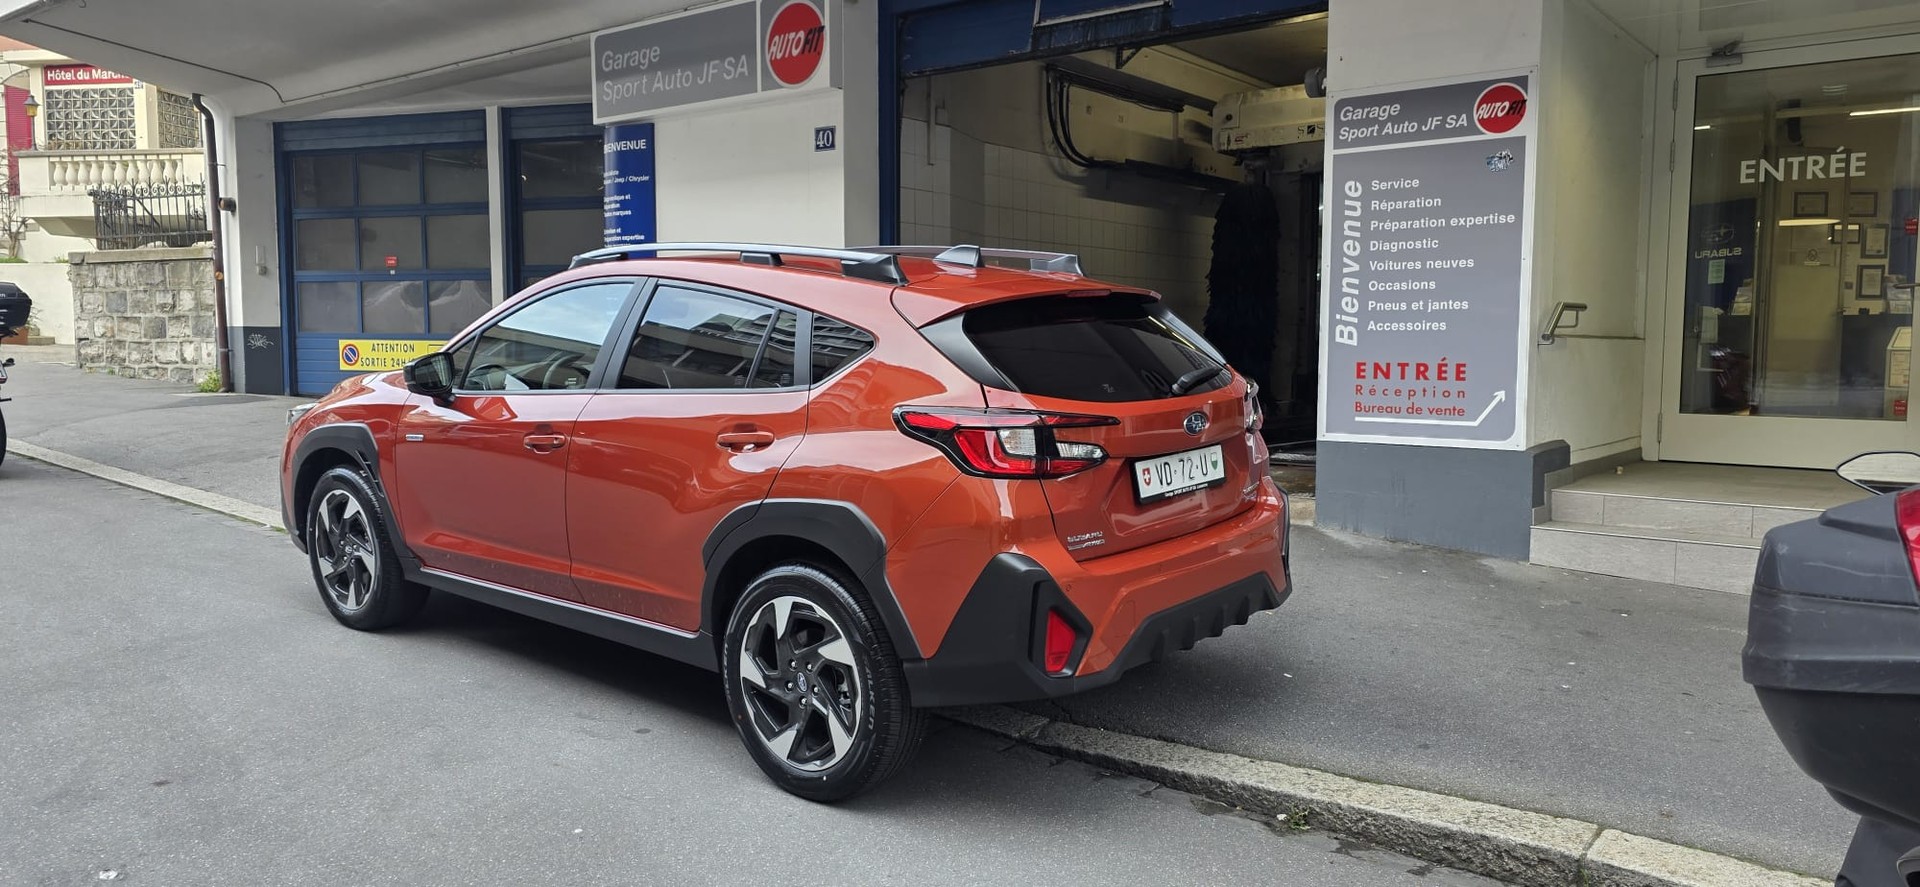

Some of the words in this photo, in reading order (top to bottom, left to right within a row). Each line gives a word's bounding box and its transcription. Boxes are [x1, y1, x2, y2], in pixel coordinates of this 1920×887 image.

[768, 25, 825, 61] AUTOFIT
[602, 46, 661, 72] Garage
[47, 69, 75, 81] Hôtel
[76, 69, 90, 80] du
[91, 68, 130, 79] Marc
[602, 75, 648, 104] Sport
[652, 69, 693, 92] Auto
[697, 60, 720, 85] JF
[723, 54, 749, 80] SA
[1340, 103, 1401, 122] Garage
[1475, 99, 1528, 120] AUTOFIT
[1338, 124, 1379, 142] Sport
[1382, 119, 1418, 136] Auto
[1421, 116, 1443, 132] JF
[1445, 113, 1468, 129] SA
[816, 130, 833, 148] 40
[1739, 145, 1868, 184] ENTRÉE
[1371, 177, 1420, 191] Service
[1371, 196, 1442, 212] Réparation
[1370, 217, 1446, 232] Préparation
[1450, 212, 1516, 229] expertise
[1369, 237, 1439, 252] Diagnostic
[1335, 180, 1362, 346] Bienvenue
[1369, 259, 1422, 271] Voitures
[1426, 257, 1475, 269] neuves
[1368, 279, 1436, 291] Occasions
[1368, 300, 1407, 311] Pneus
[1411, 300, 1424, 310] et
[1427, 298, 1469, 313] jantes
[1367, 319, 1447, 331] Accessoires
[371, 343, 415, 353] ATTENTION
[360, 357, 387, 367] SORTIE
[1355, 356, 1467, 382] ENTRÉE
[1354, 384, 1466, 400] Réception
[1354, 401, 1402, 414] Bureau
[1405, 402, 1424, 415] de
[1427, 404, 1466, 417] vente
